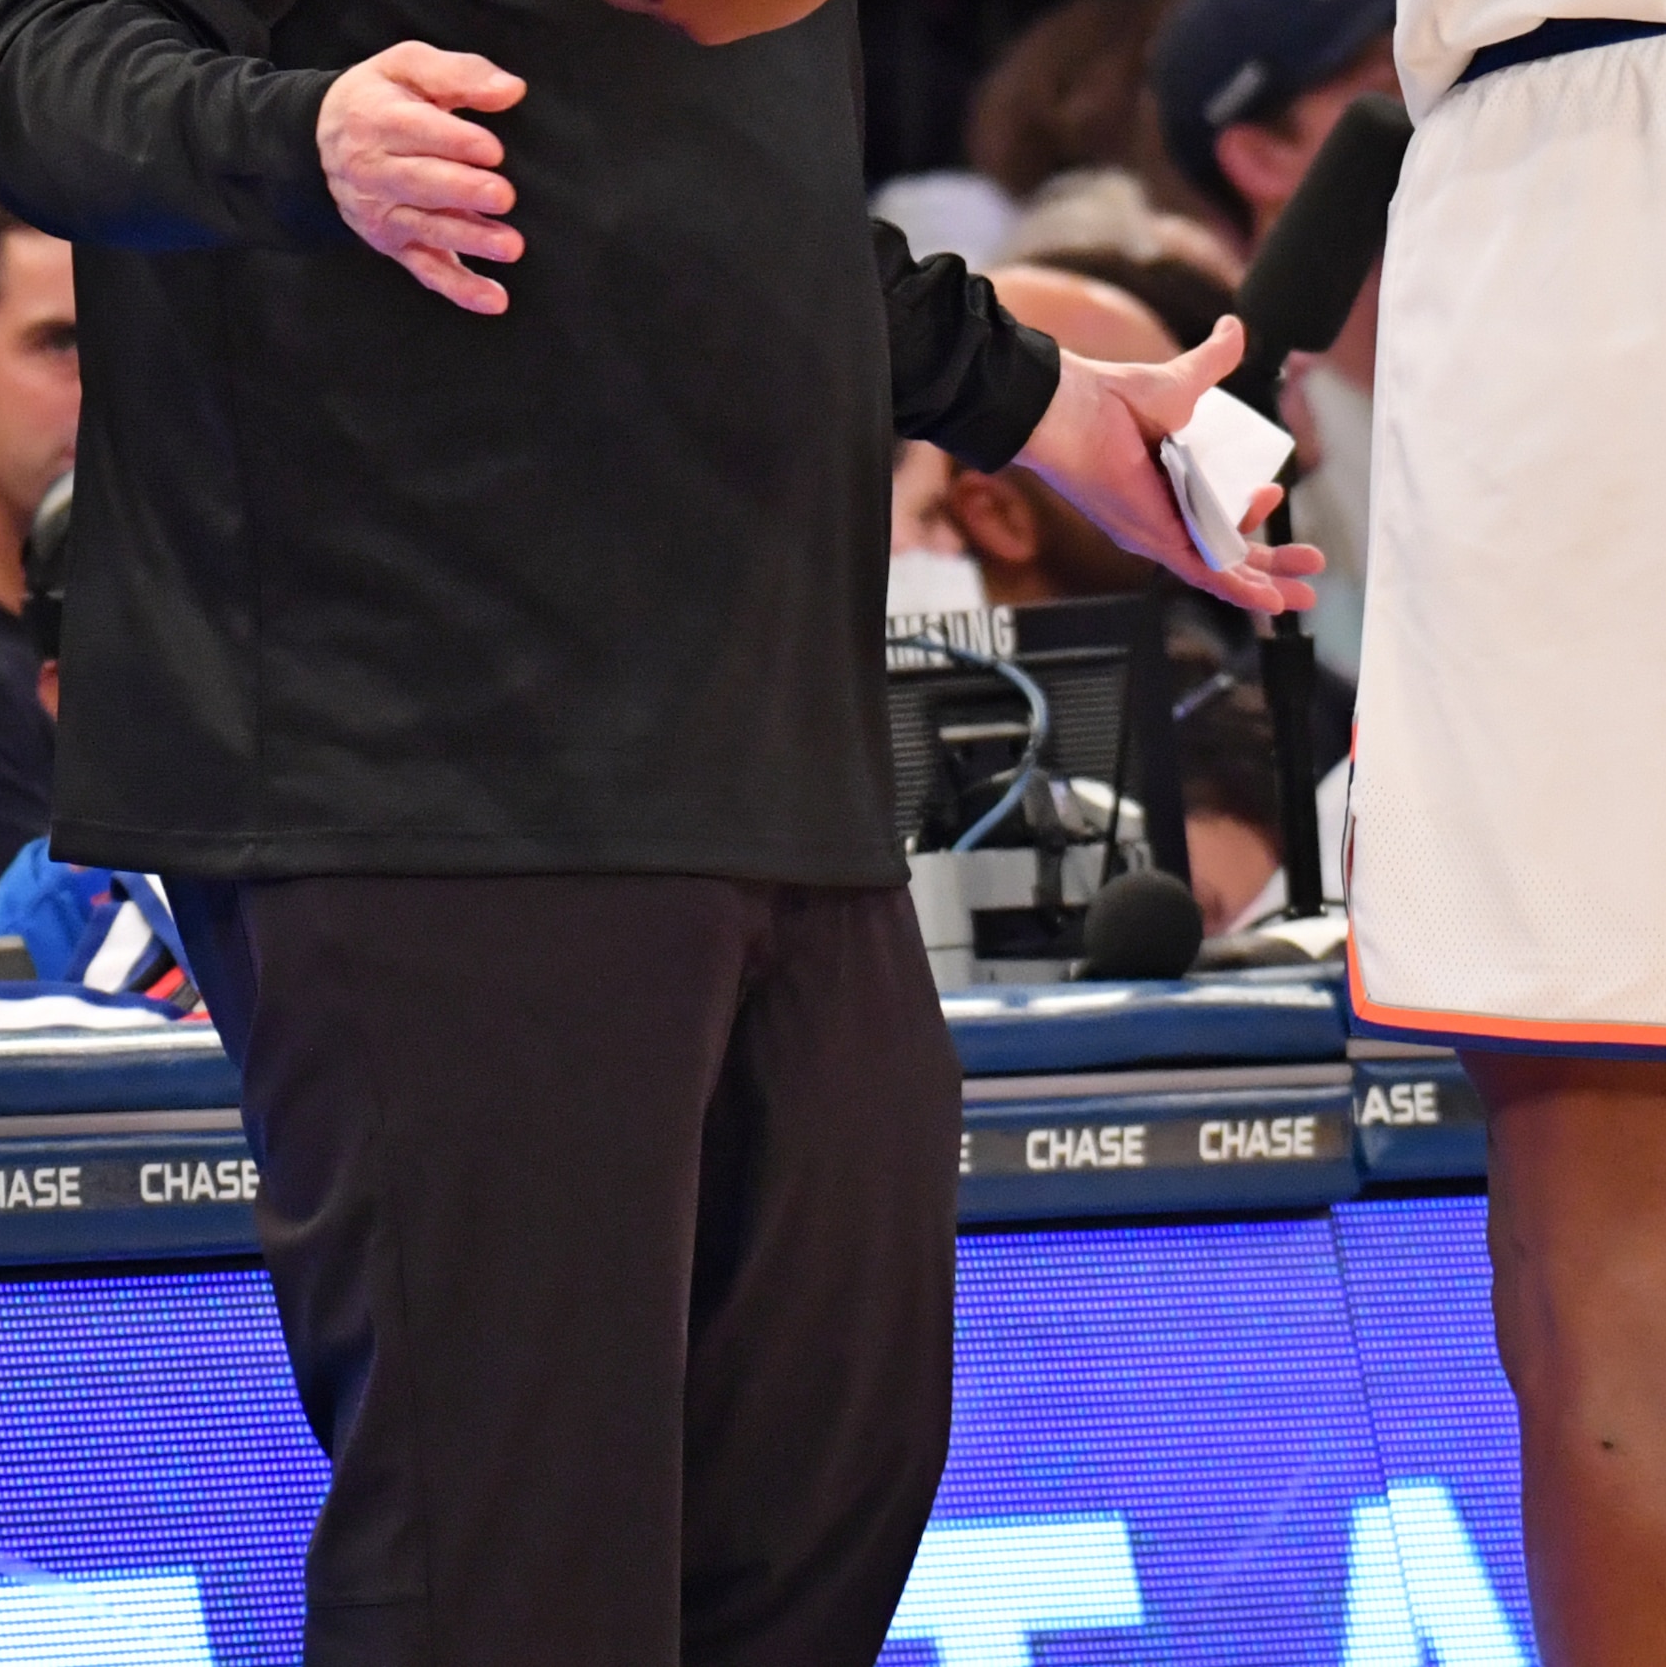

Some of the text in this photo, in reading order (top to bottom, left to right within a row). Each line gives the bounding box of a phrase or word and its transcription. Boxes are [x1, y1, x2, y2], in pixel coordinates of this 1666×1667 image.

[885, 604, 1016, 671] MSUNG
[1353, 1082, 1439, 1126] ASE
[140, 1159, 261, 1203] CHASE
[1025, 1125, 1148, 1170] CHASE
[1198, 1117, 1317, 1162] CHASE
